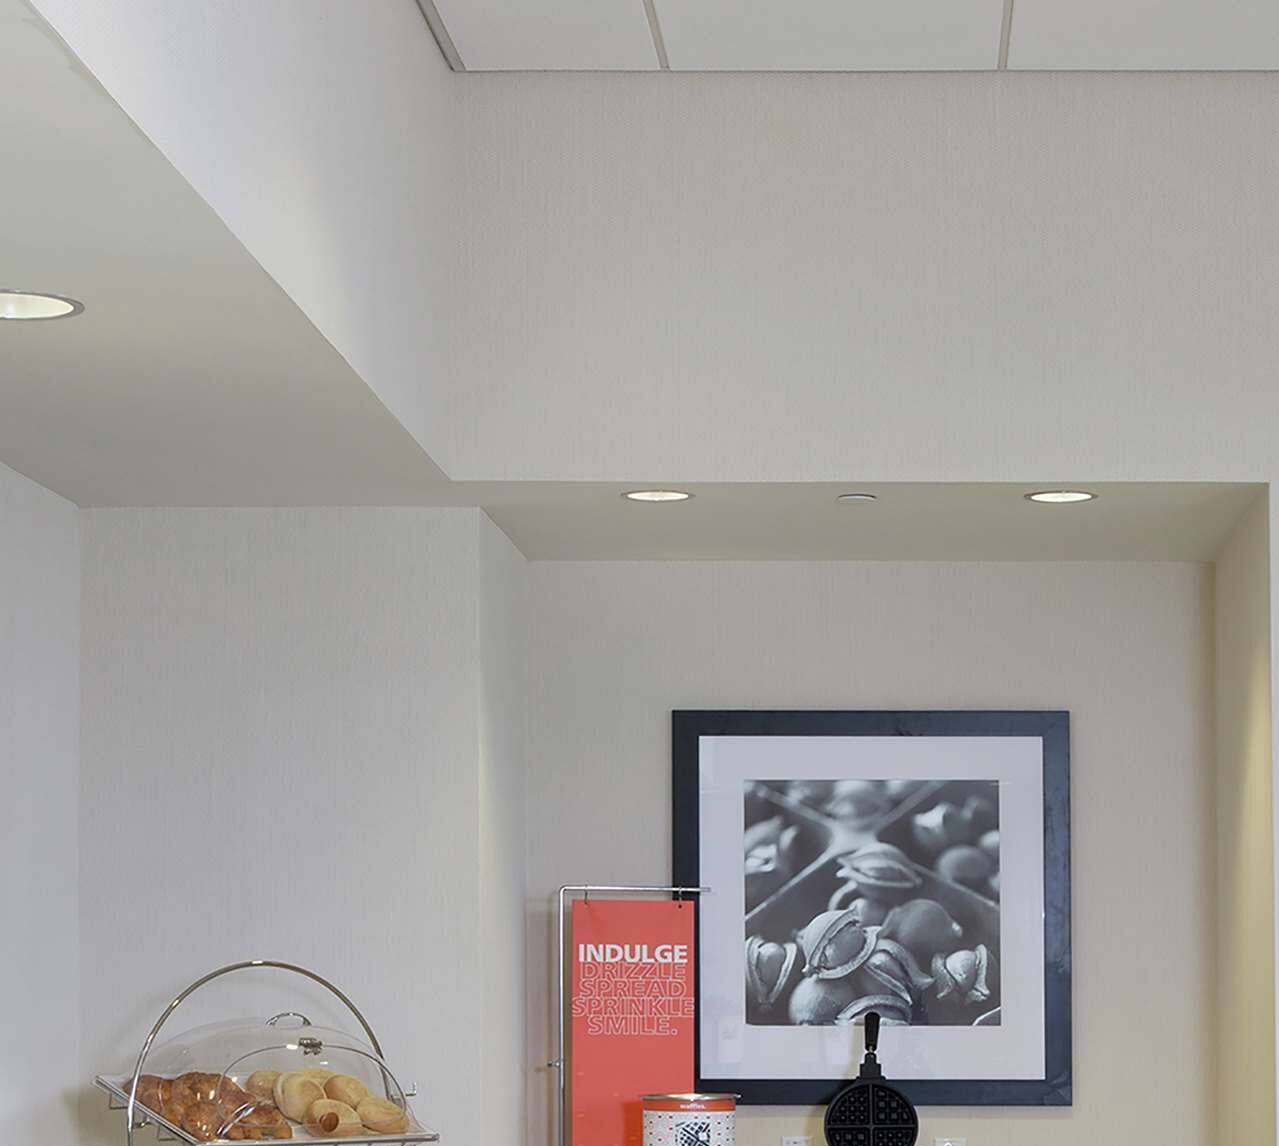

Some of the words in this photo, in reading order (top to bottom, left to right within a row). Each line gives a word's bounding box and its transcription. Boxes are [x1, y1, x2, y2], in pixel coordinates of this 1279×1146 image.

[578, 944, 688, 963] INDULGE
[580, 961, 686, 981] DRIZZLE
[580, 979, 687, 998] SPREAD
[572, 996, 694, 1017] SPRINKLE
[587, 1015, 678, 1036] SMILE.
